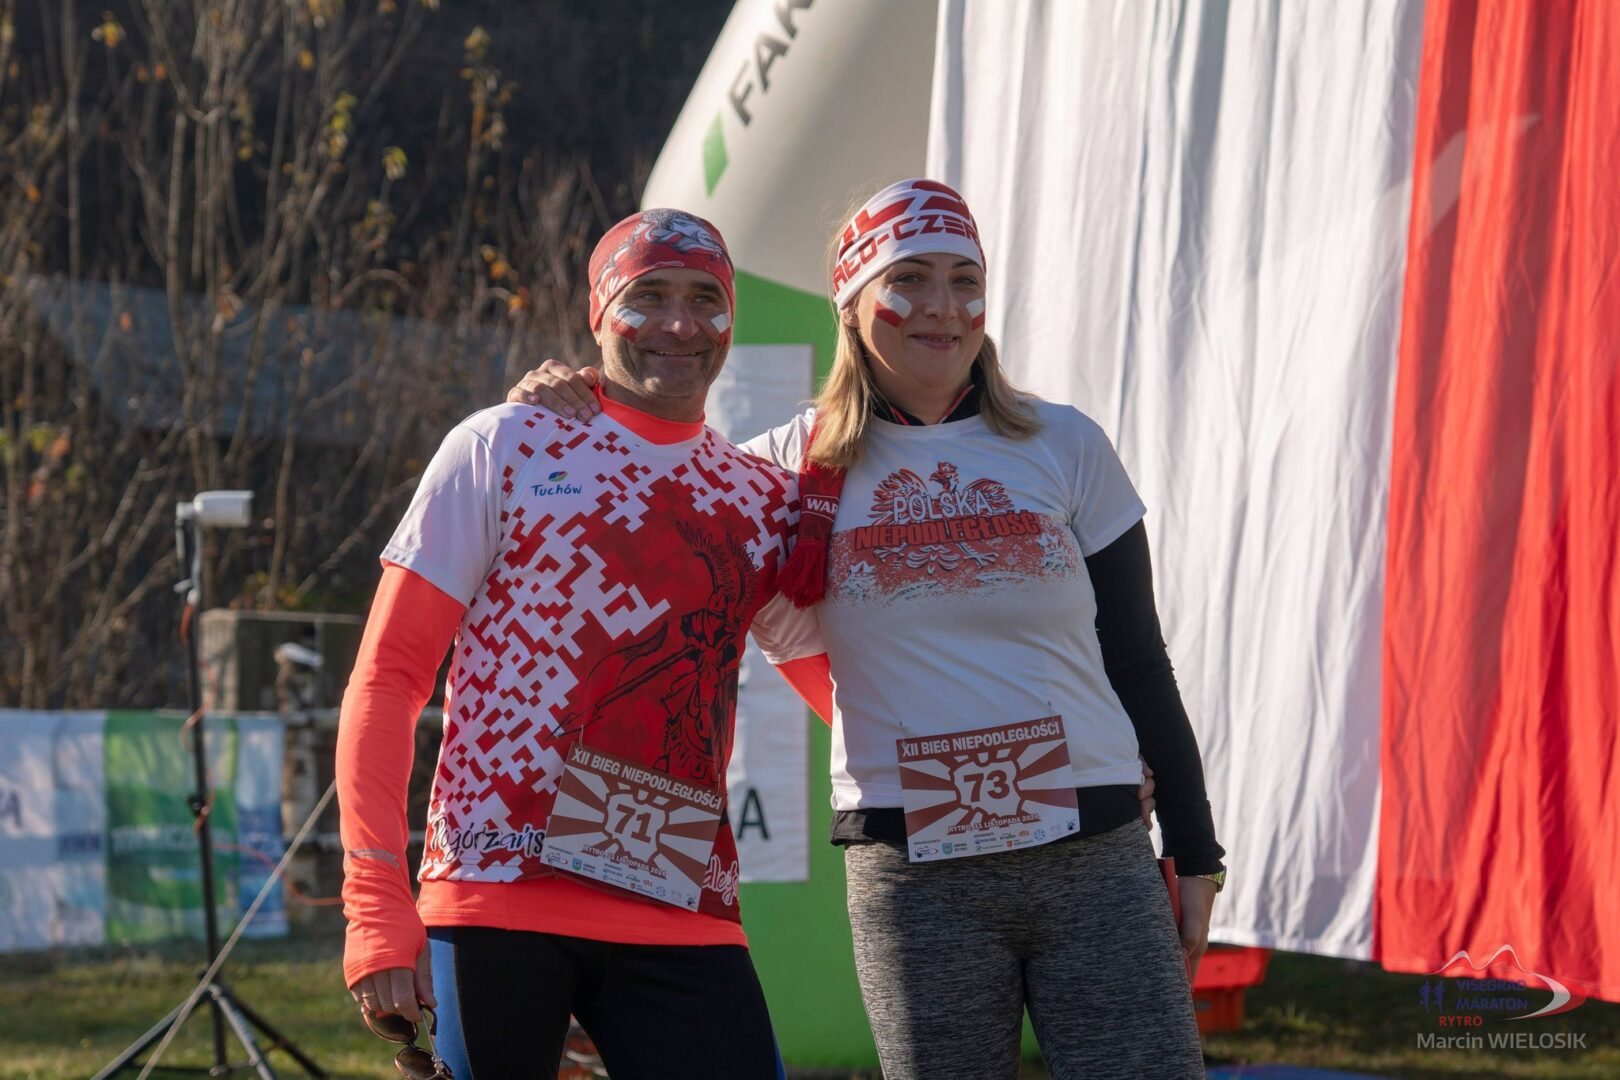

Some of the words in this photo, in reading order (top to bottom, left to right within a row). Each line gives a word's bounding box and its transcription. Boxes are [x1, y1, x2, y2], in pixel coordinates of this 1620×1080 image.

[531, 484, 582, 496] Tuchów
[893, 489, 993, 522] POLSKA
[902, 743, 919, 757] XII
[921, 738, 950, 754] BIEG
[952, 720, 1060, 751] NIEPODLEGŁOŚCI
[572, 748, 590, 765] XII
[591, 757, 620, 774] BIEG
[621, 764, 722, 810] NIEPODLEGŁOŚCI
[964, 770, 1010, 802] 73
[613, 803, 652, 843] 71
